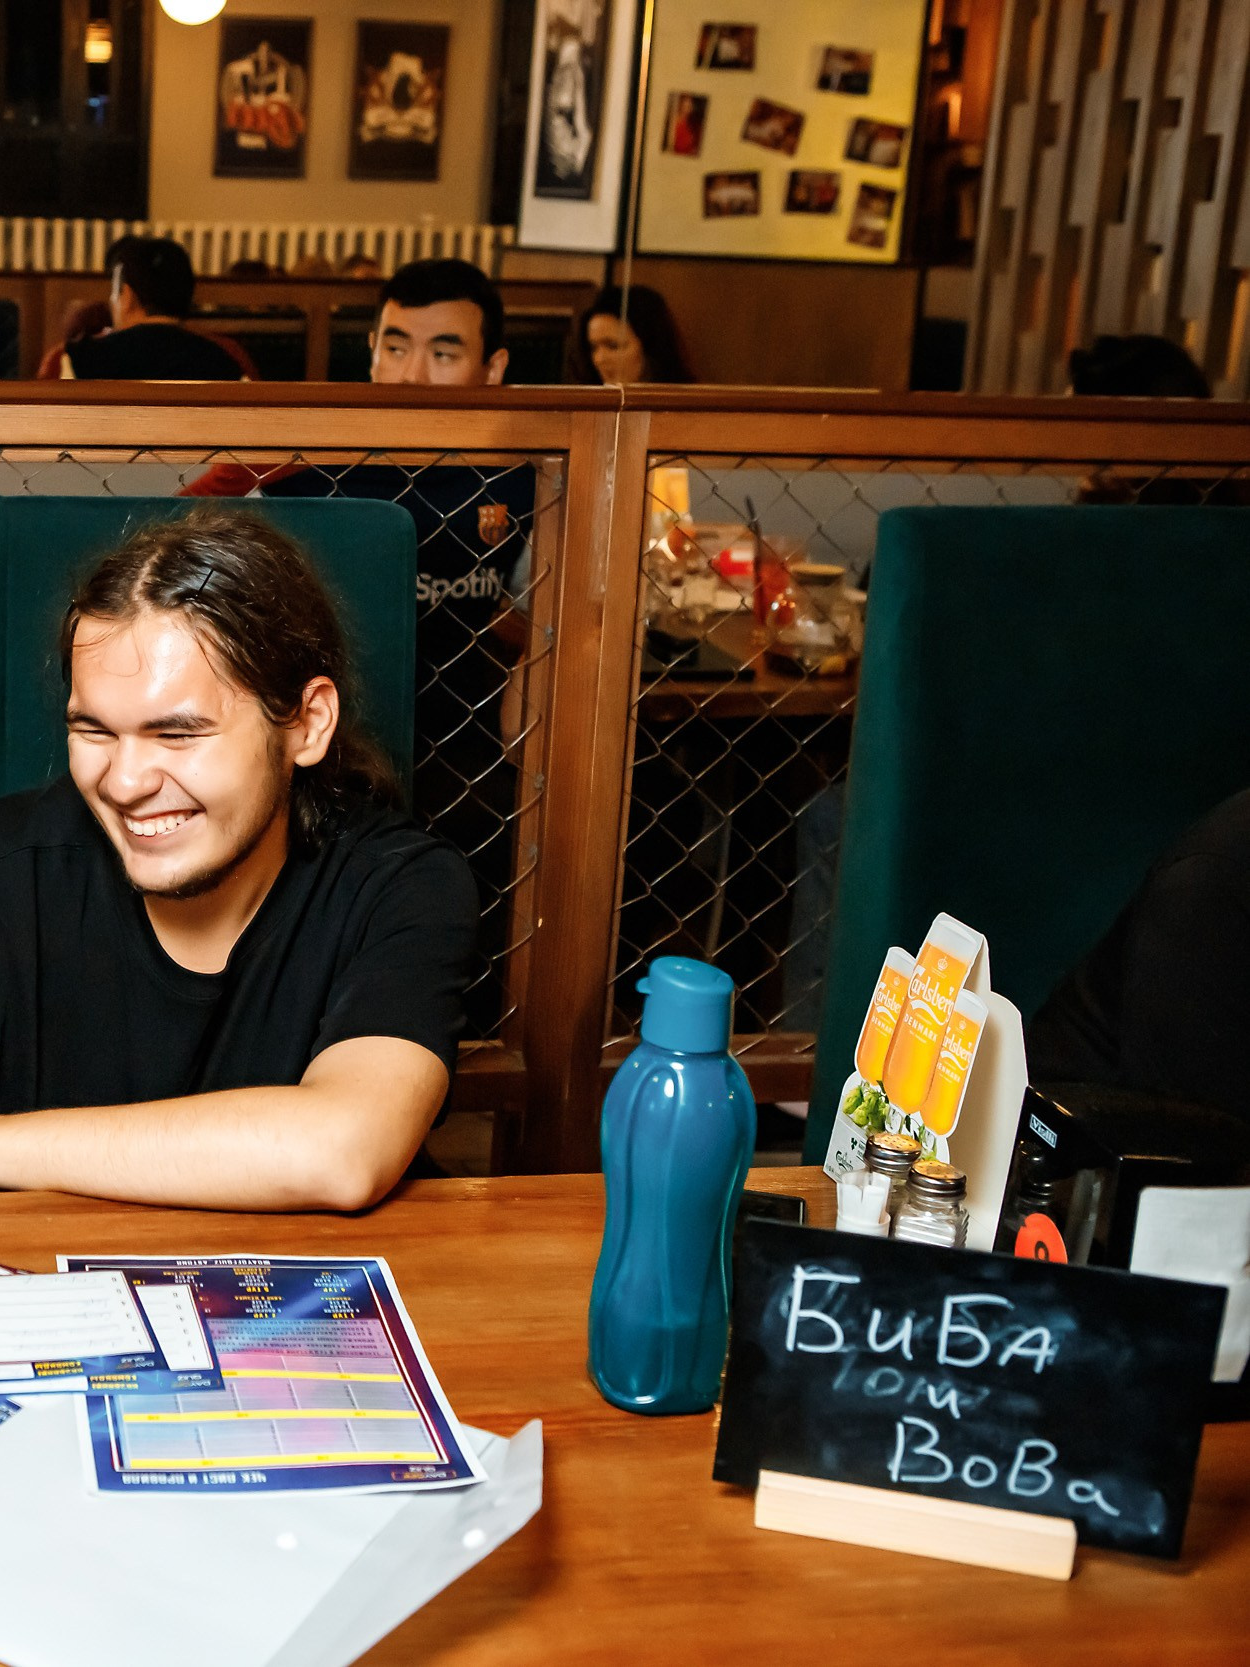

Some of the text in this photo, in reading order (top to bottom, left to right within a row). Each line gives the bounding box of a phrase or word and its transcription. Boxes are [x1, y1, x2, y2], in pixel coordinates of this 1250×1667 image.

[416, 567, 504, 605] Spotify
[873, 981, 903, 1014] Carlsbe
[907, 964, 955, 1023] Carlsberg
[903, 1013, 938, 1042] DENMARK
[943, 1027, 973, 1065] arlsberg
